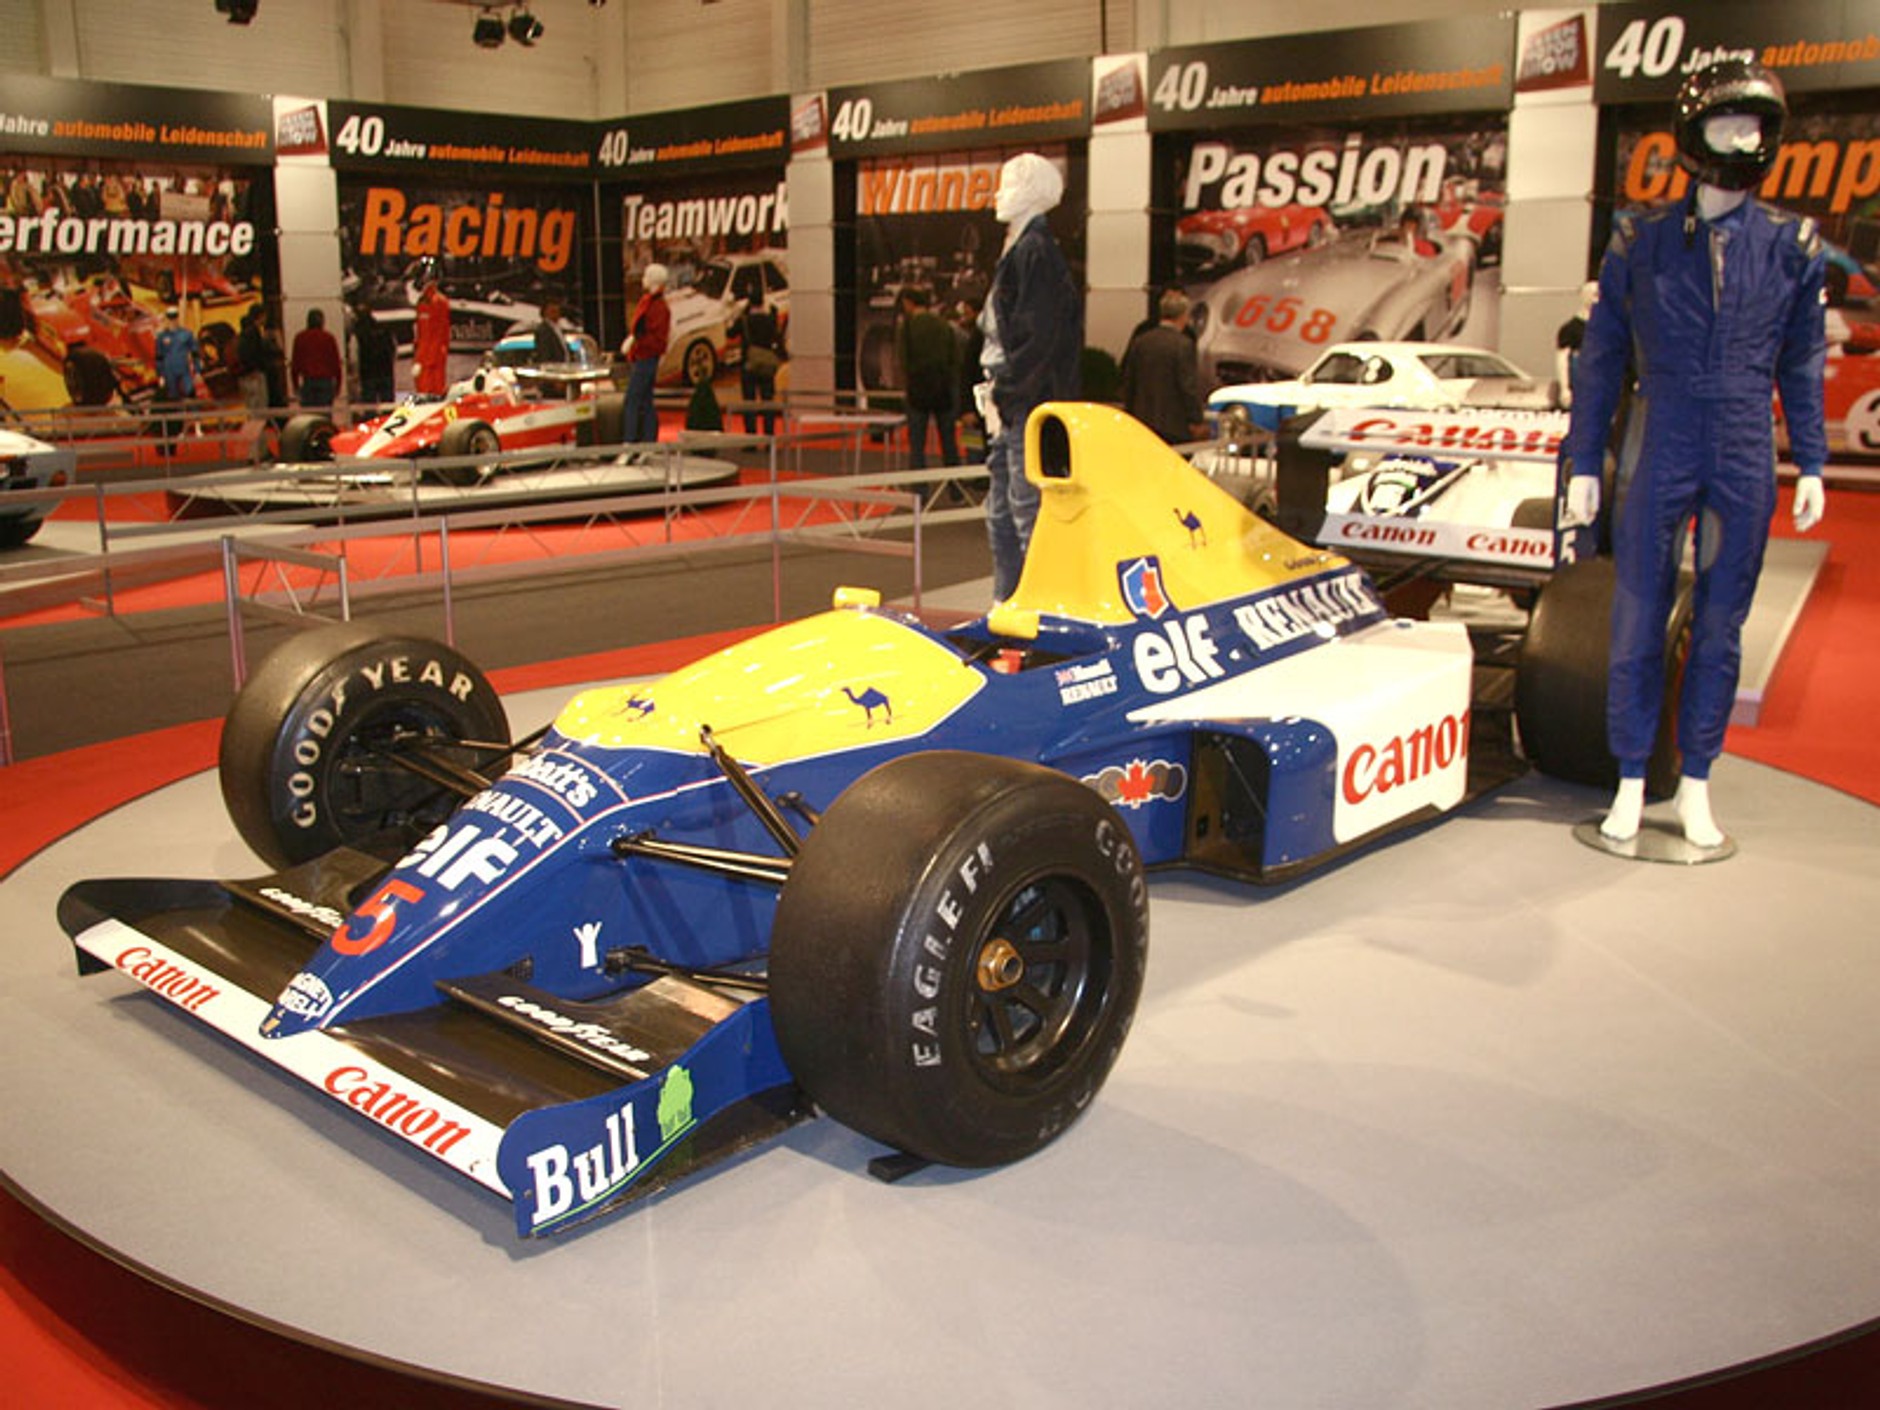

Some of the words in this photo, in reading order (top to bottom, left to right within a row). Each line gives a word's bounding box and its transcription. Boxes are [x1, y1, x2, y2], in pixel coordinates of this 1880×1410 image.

[1605, 16, 1685, 79] 40
[1681, 45, 1756, 74] Jahre
[1153, 61, 1208, 112] 40
[1206, 85, 1258, 109] Jahre
[1260, 75, 1367, 105] automobile
[1370, 63, 1504, 96] Leidenschaft
[53, 119, 156, 142] automobile
[160, 124, 267, 148] Leidenschaft
[336, 115, 385, 156] 40
[384, 139, 426, 159] Jahre
[598, 129, 629, 167] 40
[831, 98, 872, 142] 40
[870, 118, 908, 139] Jahre
[859, 162, 1001, 216] Winne
[1184, 133, 1447, 211] Passion
[1625, 131, 1880, 214] Cmp
[0, 208, 254, 256] erformance
[359, 187, 576, 274] Racing
[624, 181, 788, 241] Teamwork
[1234, 293, 1336, 345] 658
[384, 415, 407, 436] 2
[1347, 418, 1561, 453] Canon
[1341, 519, 1437, 546] Canon
[1466, 532, 1555, 558] Cano
[1233, 572, 1380, 651] RENAULT
[462, 790, 564, 849] NAULT
[394, 824, 519, 891] elf
[330, 879, 426, 956] 5
[114, 946, 221, 1012] Canon
[323, 1065, 472, 1156] Canon
[526, 1101, 640, 1226] Bull
